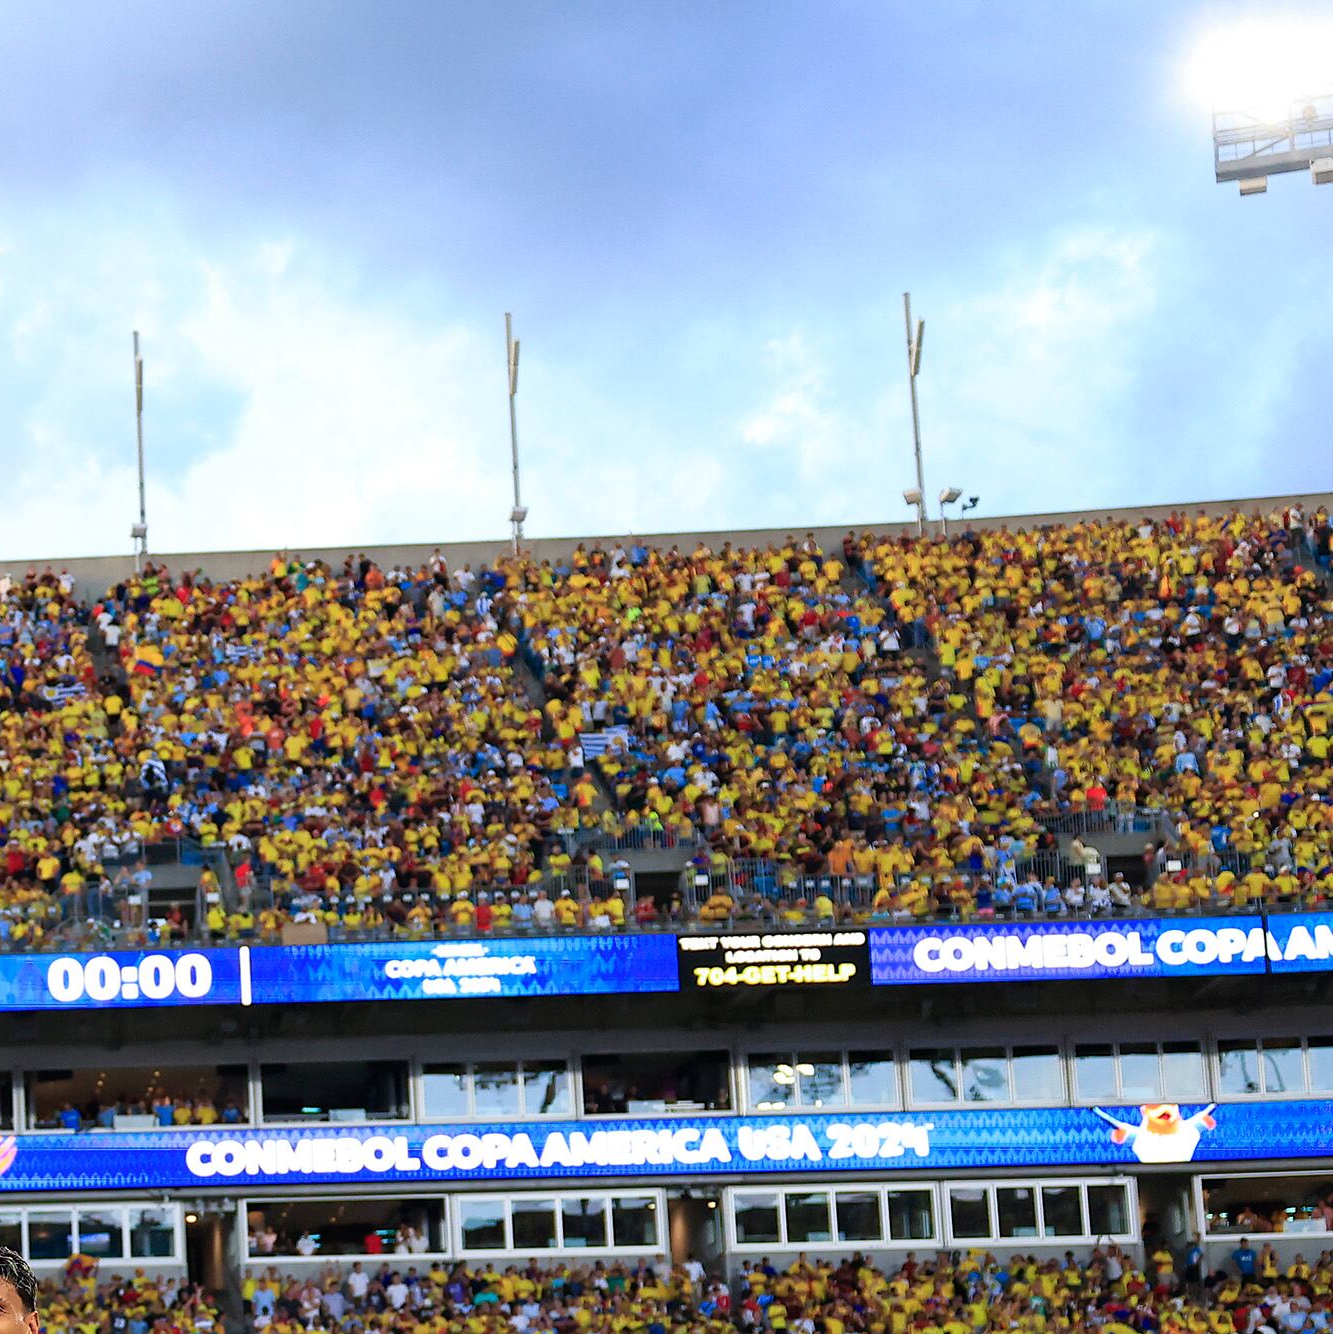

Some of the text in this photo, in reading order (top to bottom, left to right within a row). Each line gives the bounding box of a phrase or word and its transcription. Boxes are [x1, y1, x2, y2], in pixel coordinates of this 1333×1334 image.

[913, 931, 1154, 972] CONMEBOL
[1156, 928, 1282, 965] COPA
[48, 954, 212, 1002] 00:00
[186, 1122, 931, 1177] CONMEBOL COPA AMERICA USA 2024
